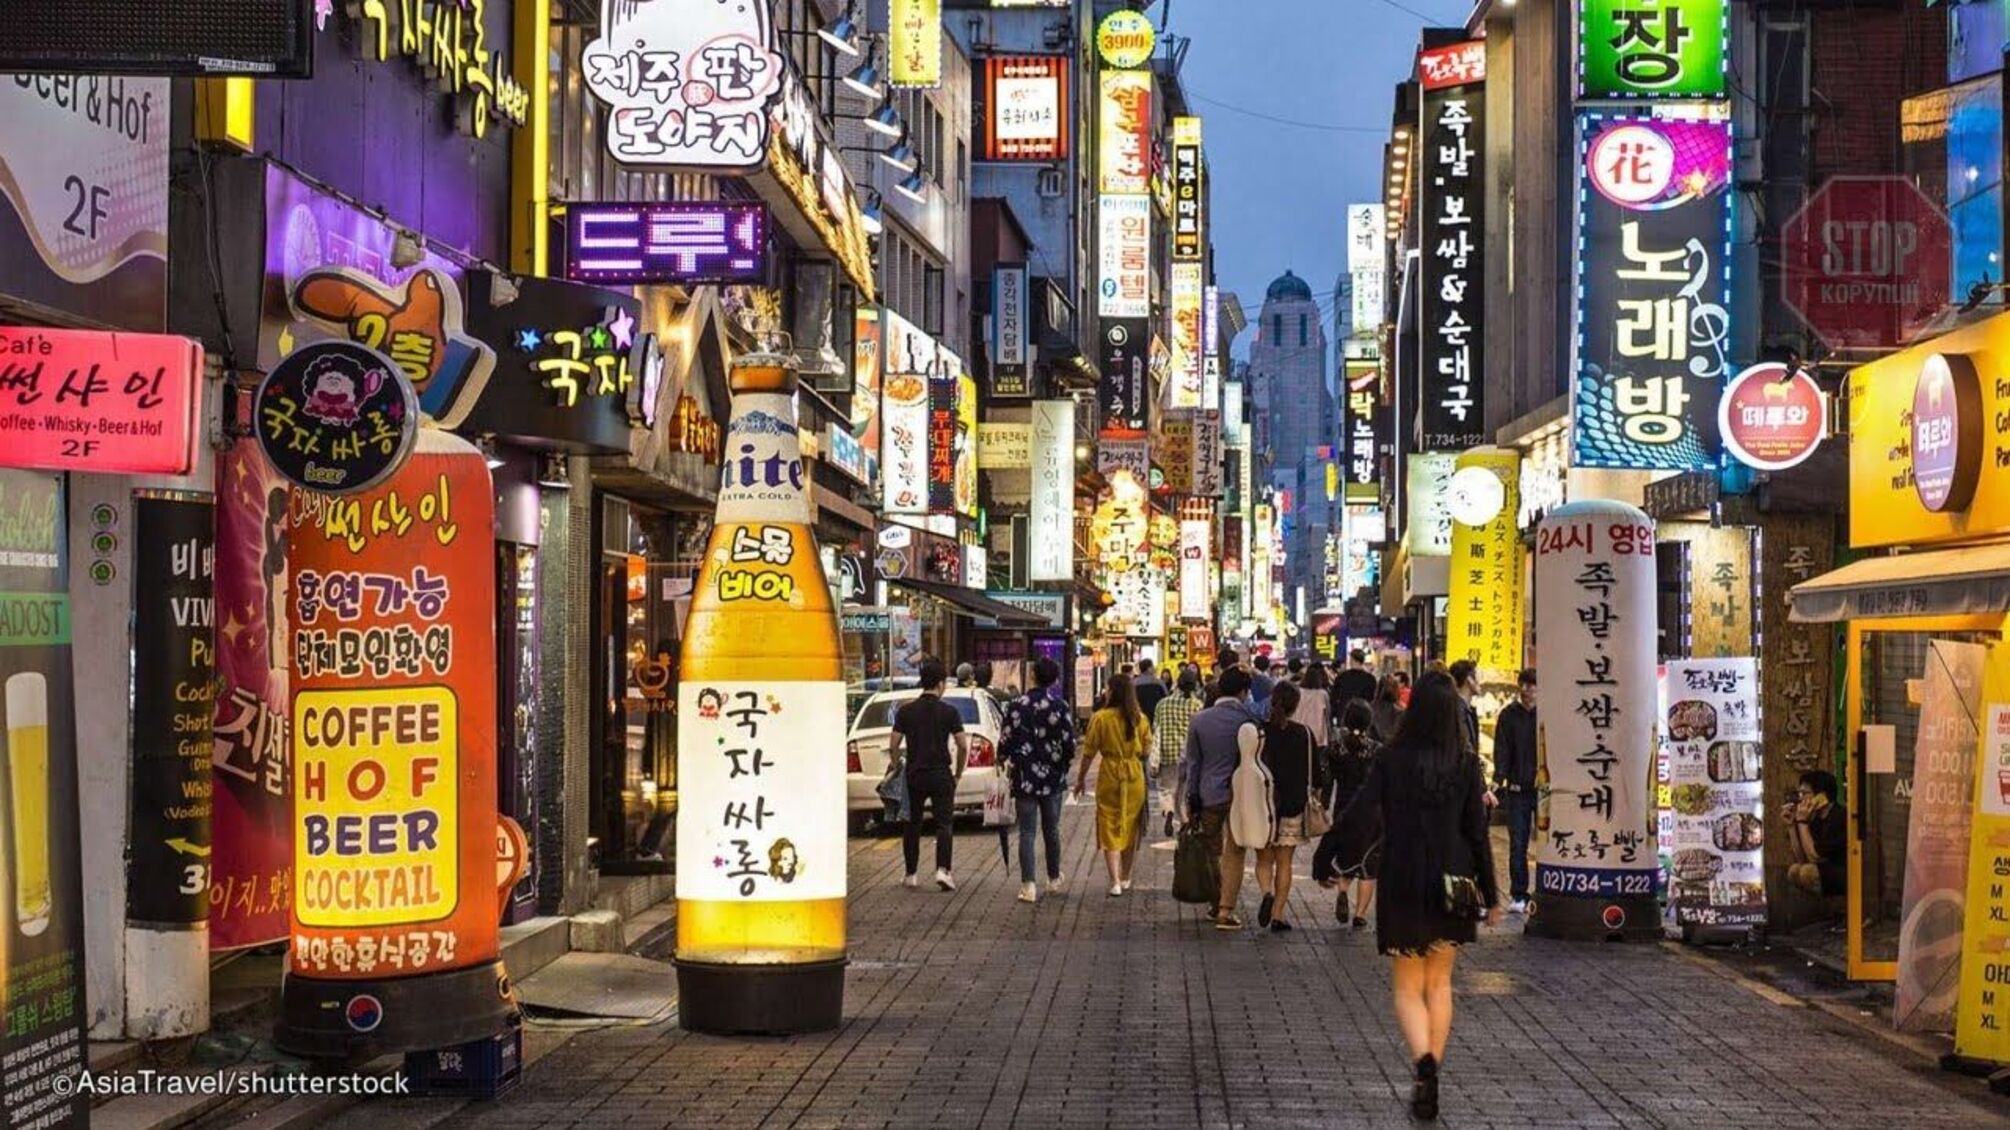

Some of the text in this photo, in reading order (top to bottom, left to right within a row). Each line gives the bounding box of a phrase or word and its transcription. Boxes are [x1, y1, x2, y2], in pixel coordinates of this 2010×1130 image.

[1610, 6, 1691, 84] 장
[617, 105, 761, 157] 도야지
[1608, 142, 1656, 185] 花
[63, 174, 111, 241] 2F
[1616, 221, 1691, 443] 노래방
[539, 331, 633, 407] 국자
[61, 440, 100, 457] 2F
[758, 491, 792, 501] COLD
[1540, 524, 1652, 556] 24시 영업
[298, 565, 450, 622] 흡연가능
[297, 625, 452, 679] 단체모임환영
[303, 702, 440, 748] COFFEE
[724, 690, 775, 897] 국자싸롱
[305, 809, 438, 856] BEER
[303, 862, 440, 911] COCKTAIL
[1543, 870, 1651, 894] 02)734-1222
[1990, 883, 2003, 898] M
[1989, 906, 2008, 922] XL
[1982, 991, 1994, 1006] M
[1980, 1014, 2000, 1030] XL
